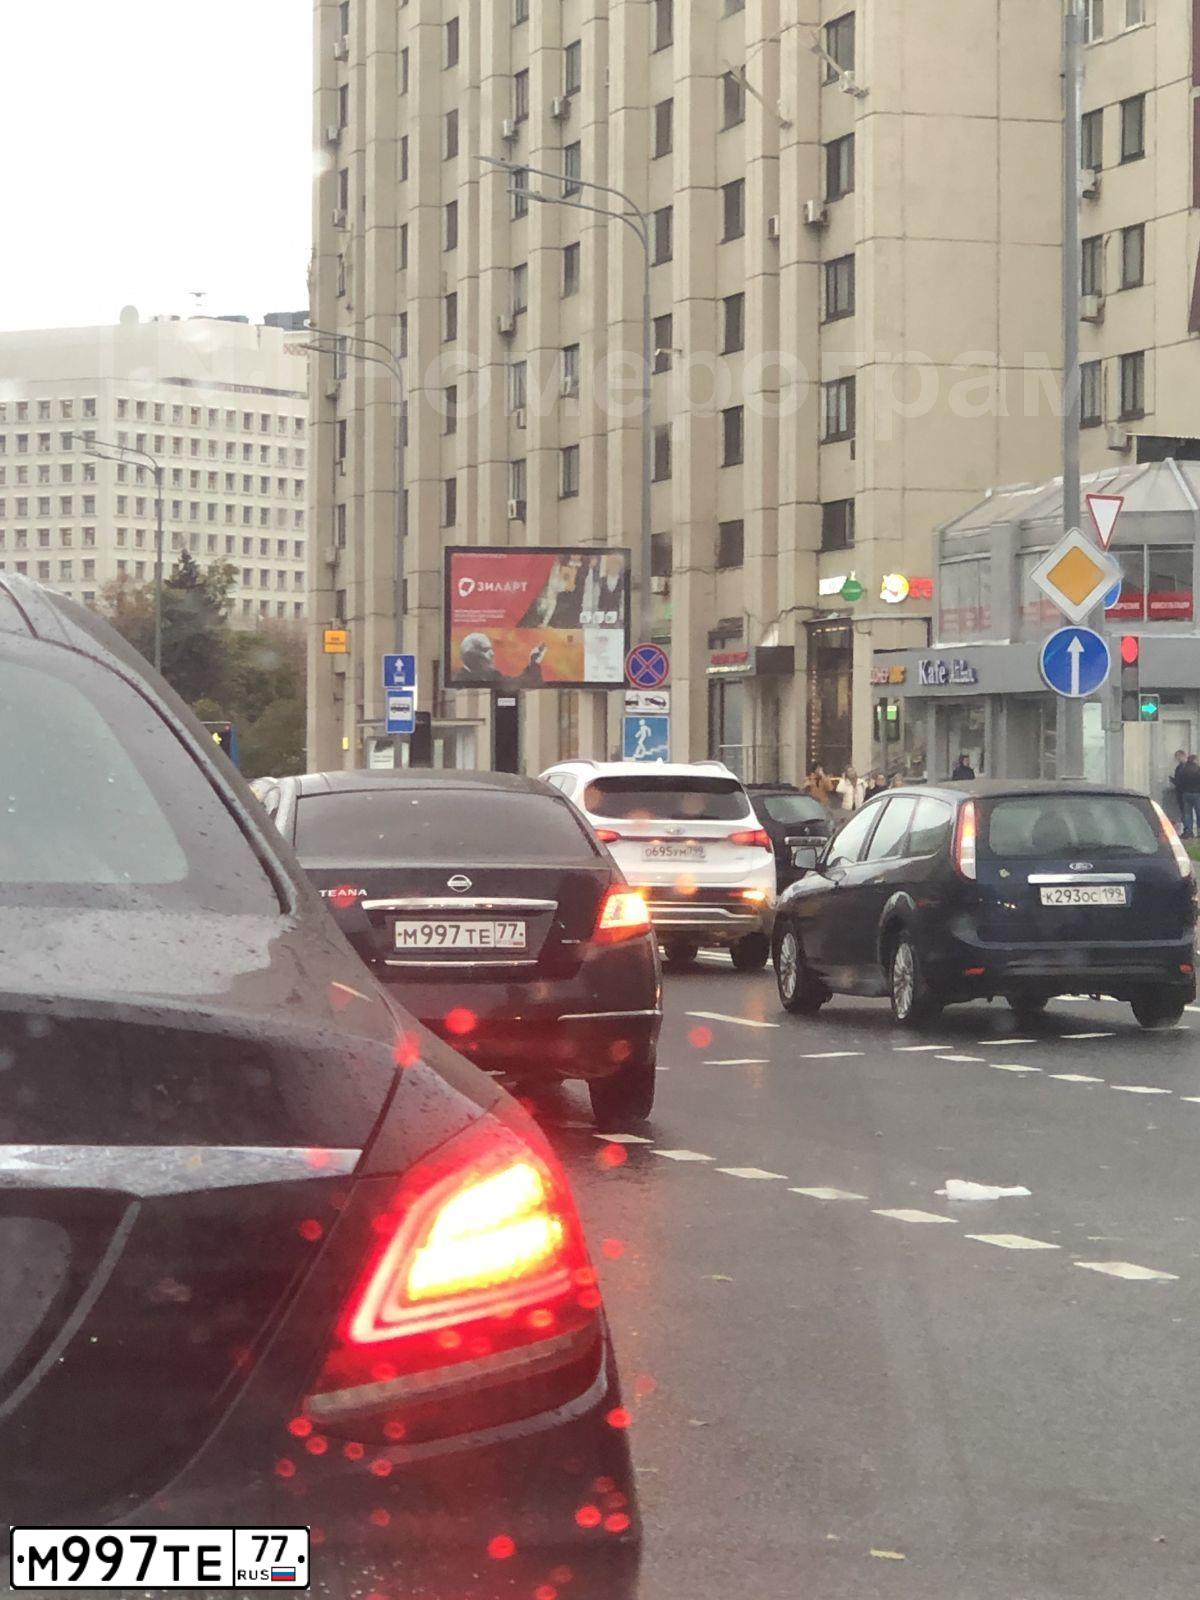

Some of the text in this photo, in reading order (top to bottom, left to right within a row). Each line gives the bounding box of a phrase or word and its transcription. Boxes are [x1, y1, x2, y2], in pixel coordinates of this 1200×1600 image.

[477, 581, 527, 592] ЗИЛАРТ
[919, 660, 946, 684] Kafe
[318, 888, 368, 898] TEANA
[1046, 888, 1122, 903] К293ОС 199
[403, 923, 518, 945] М997ТЕ 77
